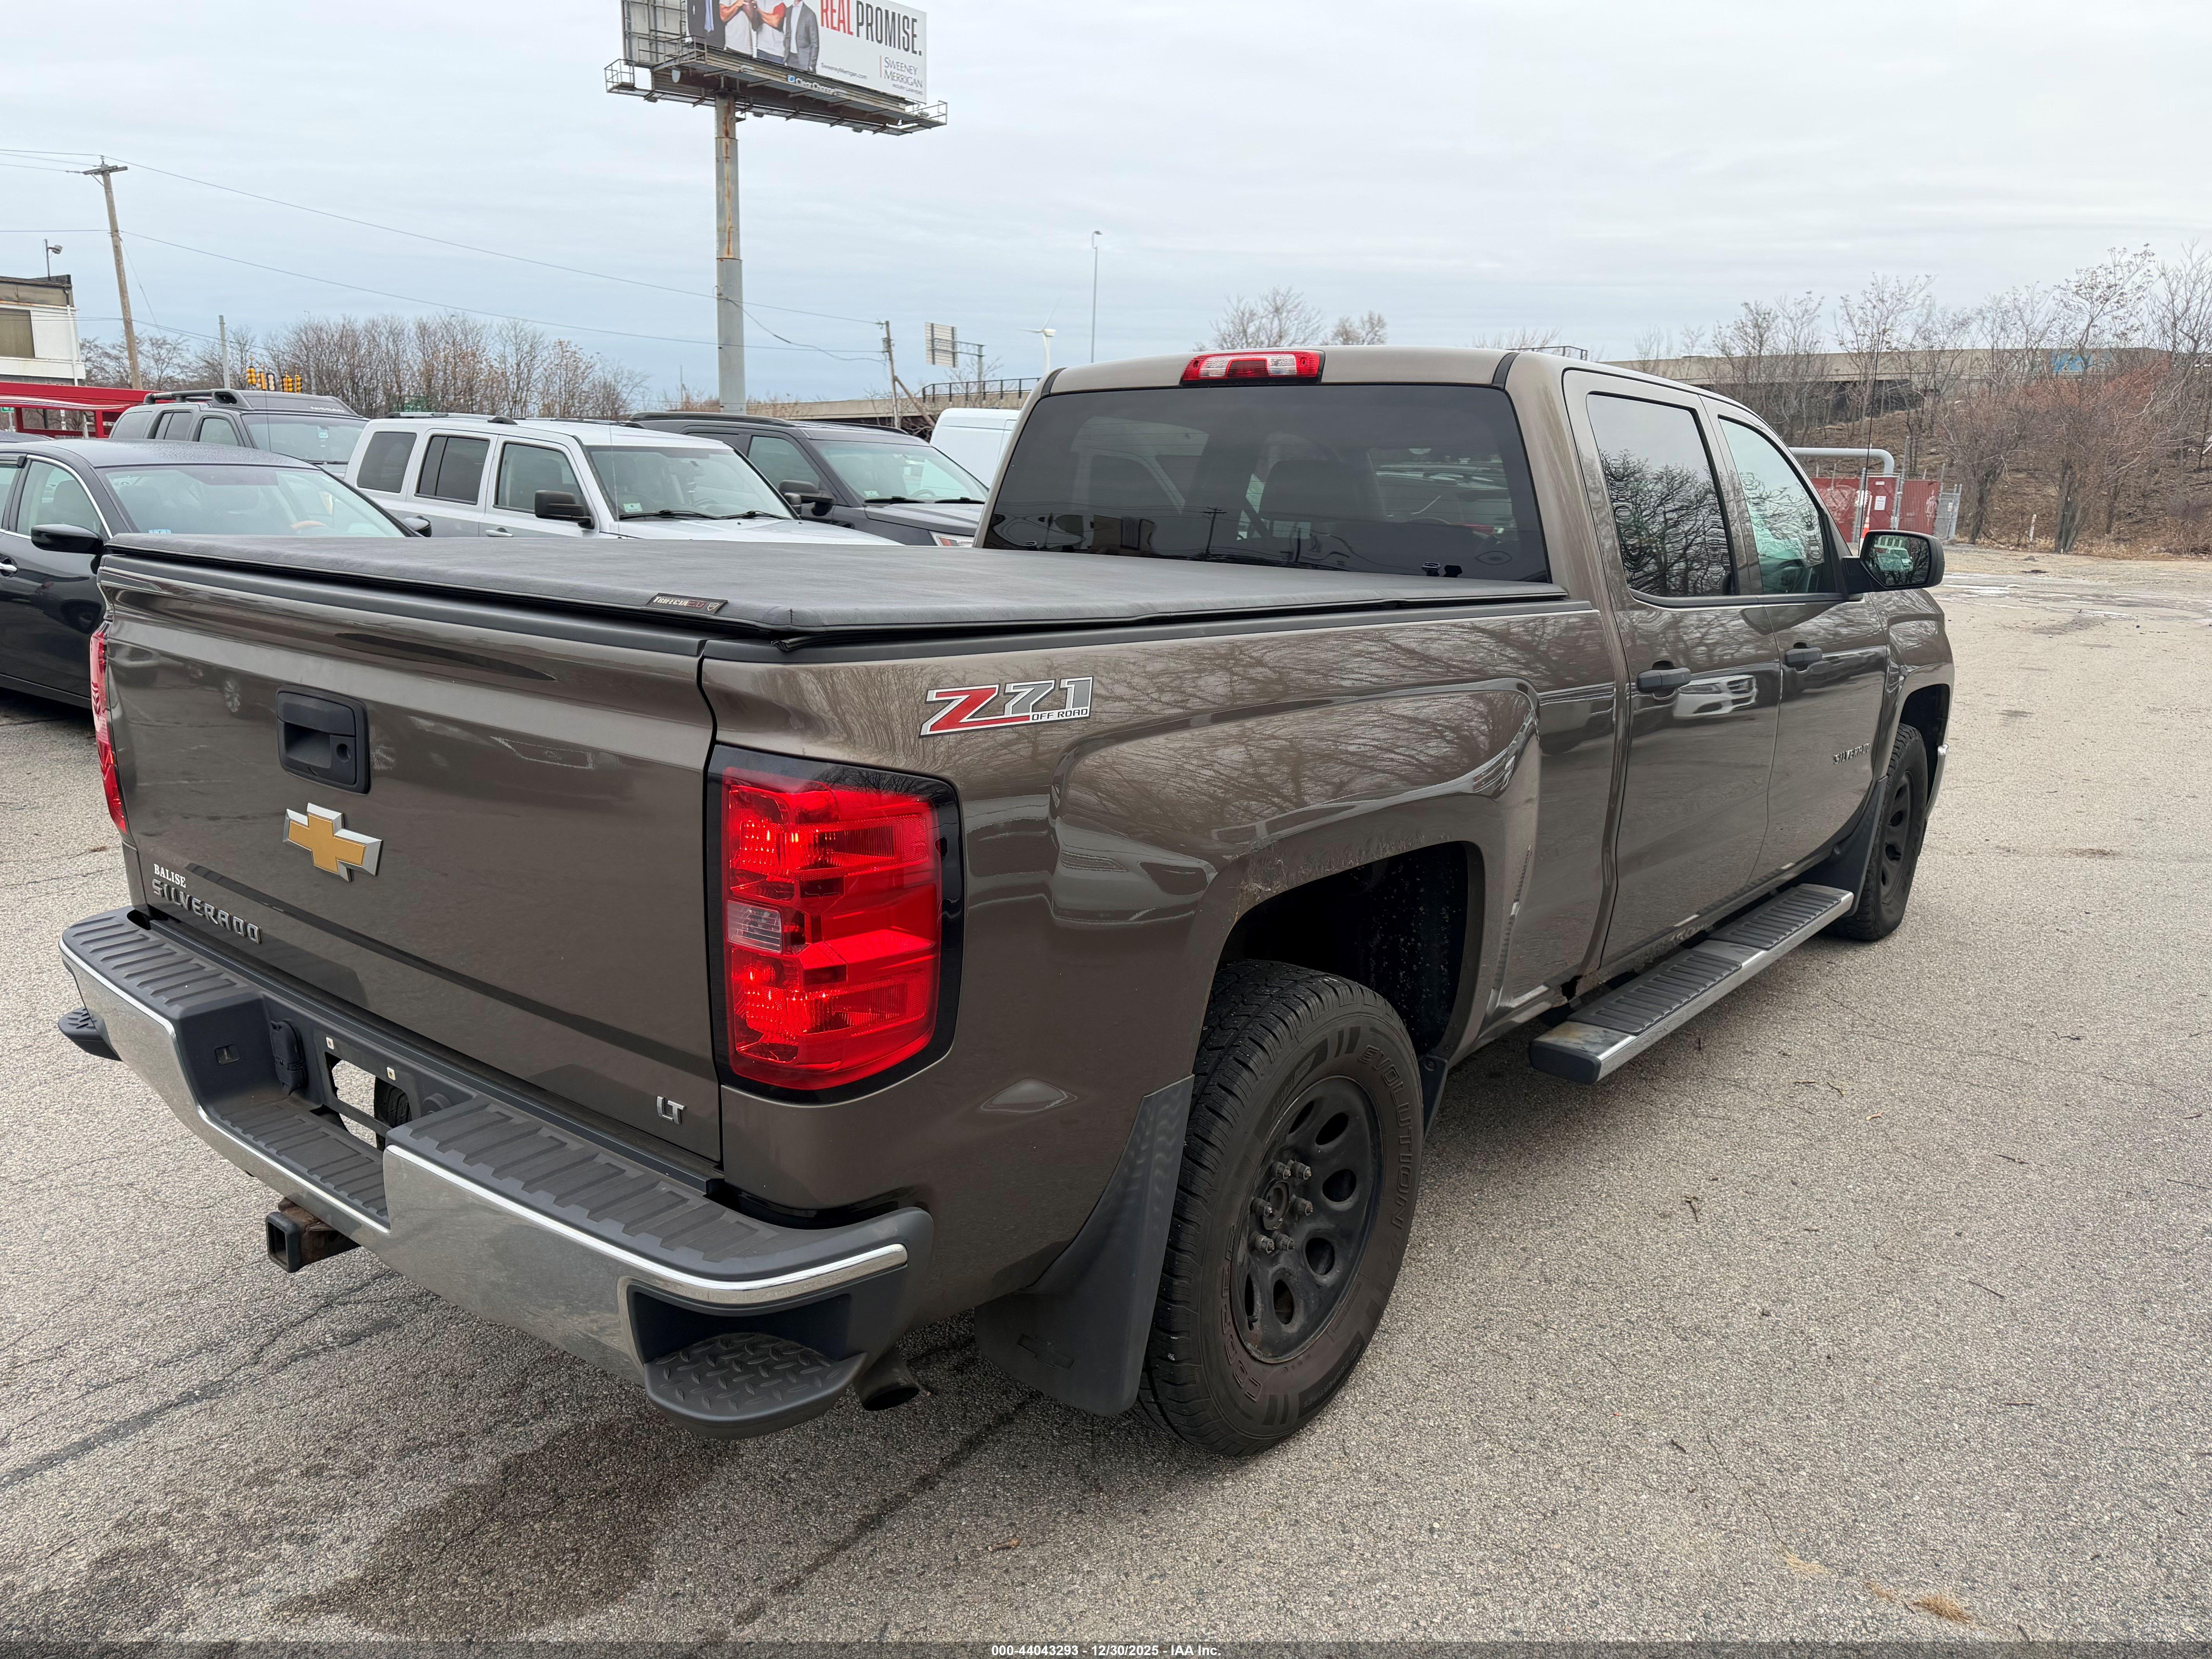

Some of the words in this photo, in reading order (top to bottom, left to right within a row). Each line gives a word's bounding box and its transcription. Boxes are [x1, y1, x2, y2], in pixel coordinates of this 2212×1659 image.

[821, 0, 854, 35] REAL
[856, 0, 922, 56] PROMISE.
[884, 57, 918, 75] SWEENEY
[884, 69, 923, 88] MERRIGAN
[919, 676, 1094, 736] Z71
[1032, 712, 1054, 721] OFF
[1057, 708, 1088, 718] ROAD
[1833, 743, 1871, 765] SILVERADO
[154, 863, 186, 888] BALISE
[152, 878, 263, 944] SILVERADO
[657, 1096, 685, 1125] LT
[1358, 1044, 1412, 1230] EVOLUTION
[1221, 1224, 1263, 1403] COOPER
